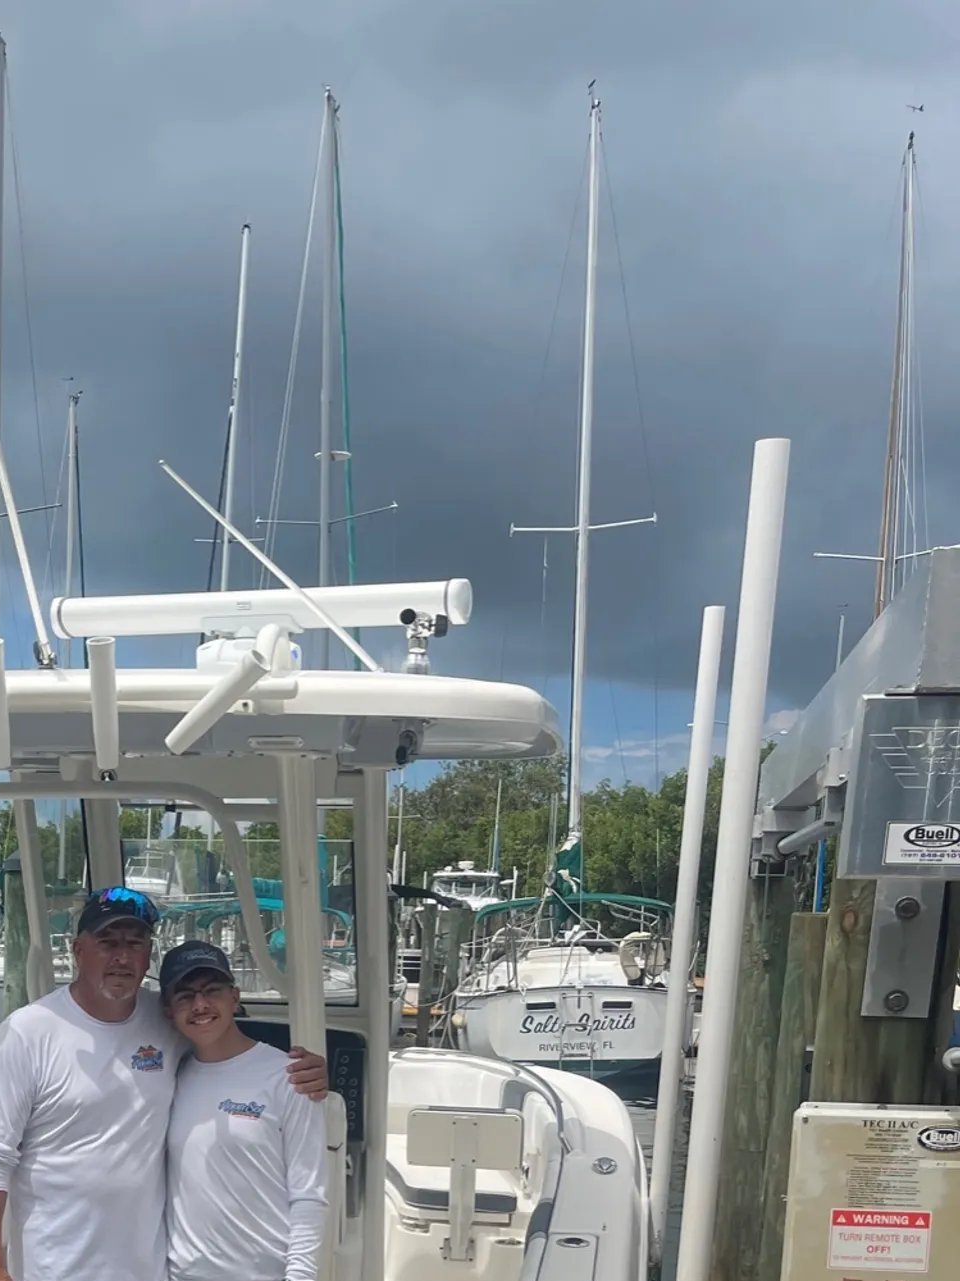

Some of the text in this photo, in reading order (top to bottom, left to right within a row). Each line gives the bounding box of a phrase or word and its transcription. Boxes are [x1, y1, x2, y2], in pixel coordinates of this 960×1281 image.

[915, 827, 954, 839] Buell
[575, 1013, 636, 1036] Spirits
[603, 1041, 615, 1050] FL
[861, 1120, 884, 1128] TEC
[899, 1121, 919, 1129] A/C
[852, 1214, 910, 1225] WARNING
[838, 1232, 922, 1244] TURN REMOTE BOX
[866, 1244, 891, 1254] OFF!
